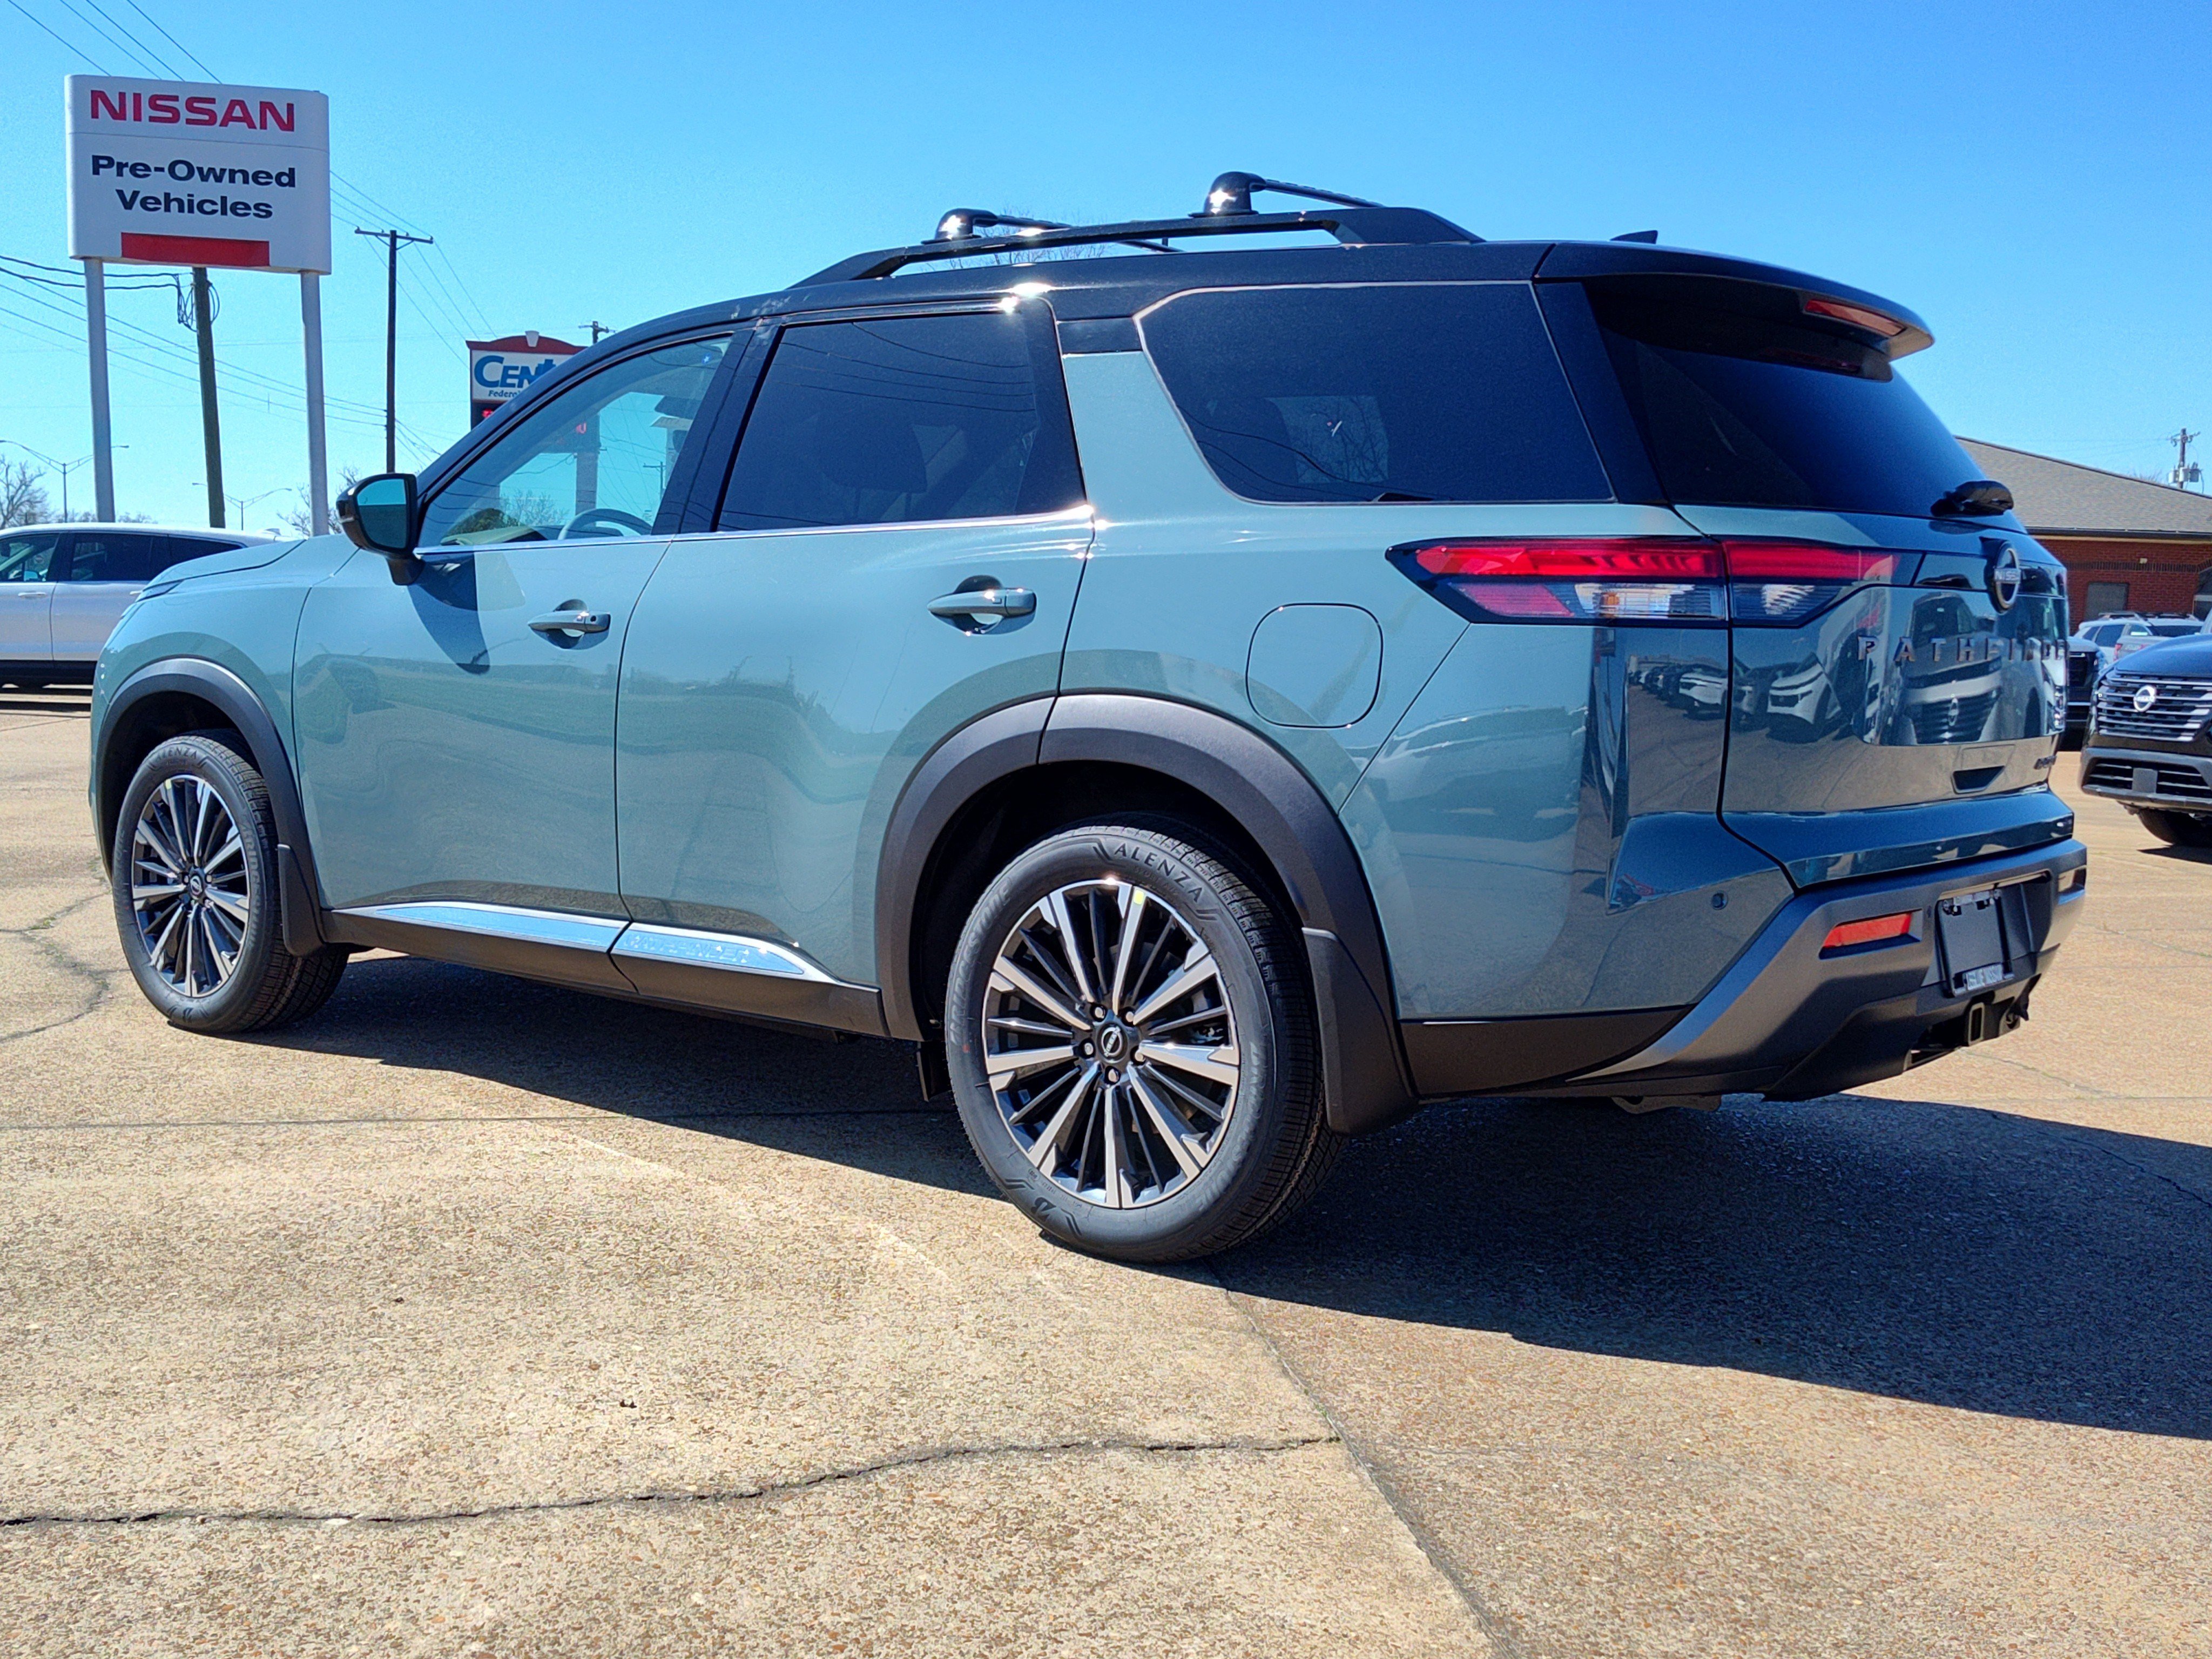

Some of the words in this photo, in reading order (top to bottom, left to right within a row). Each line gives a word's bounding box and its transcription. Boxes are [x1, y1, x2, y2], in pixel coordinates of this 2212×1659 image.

[91, 90, 295, 132] NISSAN
[91, 154, 295, 187] Pre-Owned
[115, 189, 273, 219] Vehicles
[1114, 843, 1203, 902] ALENZA
